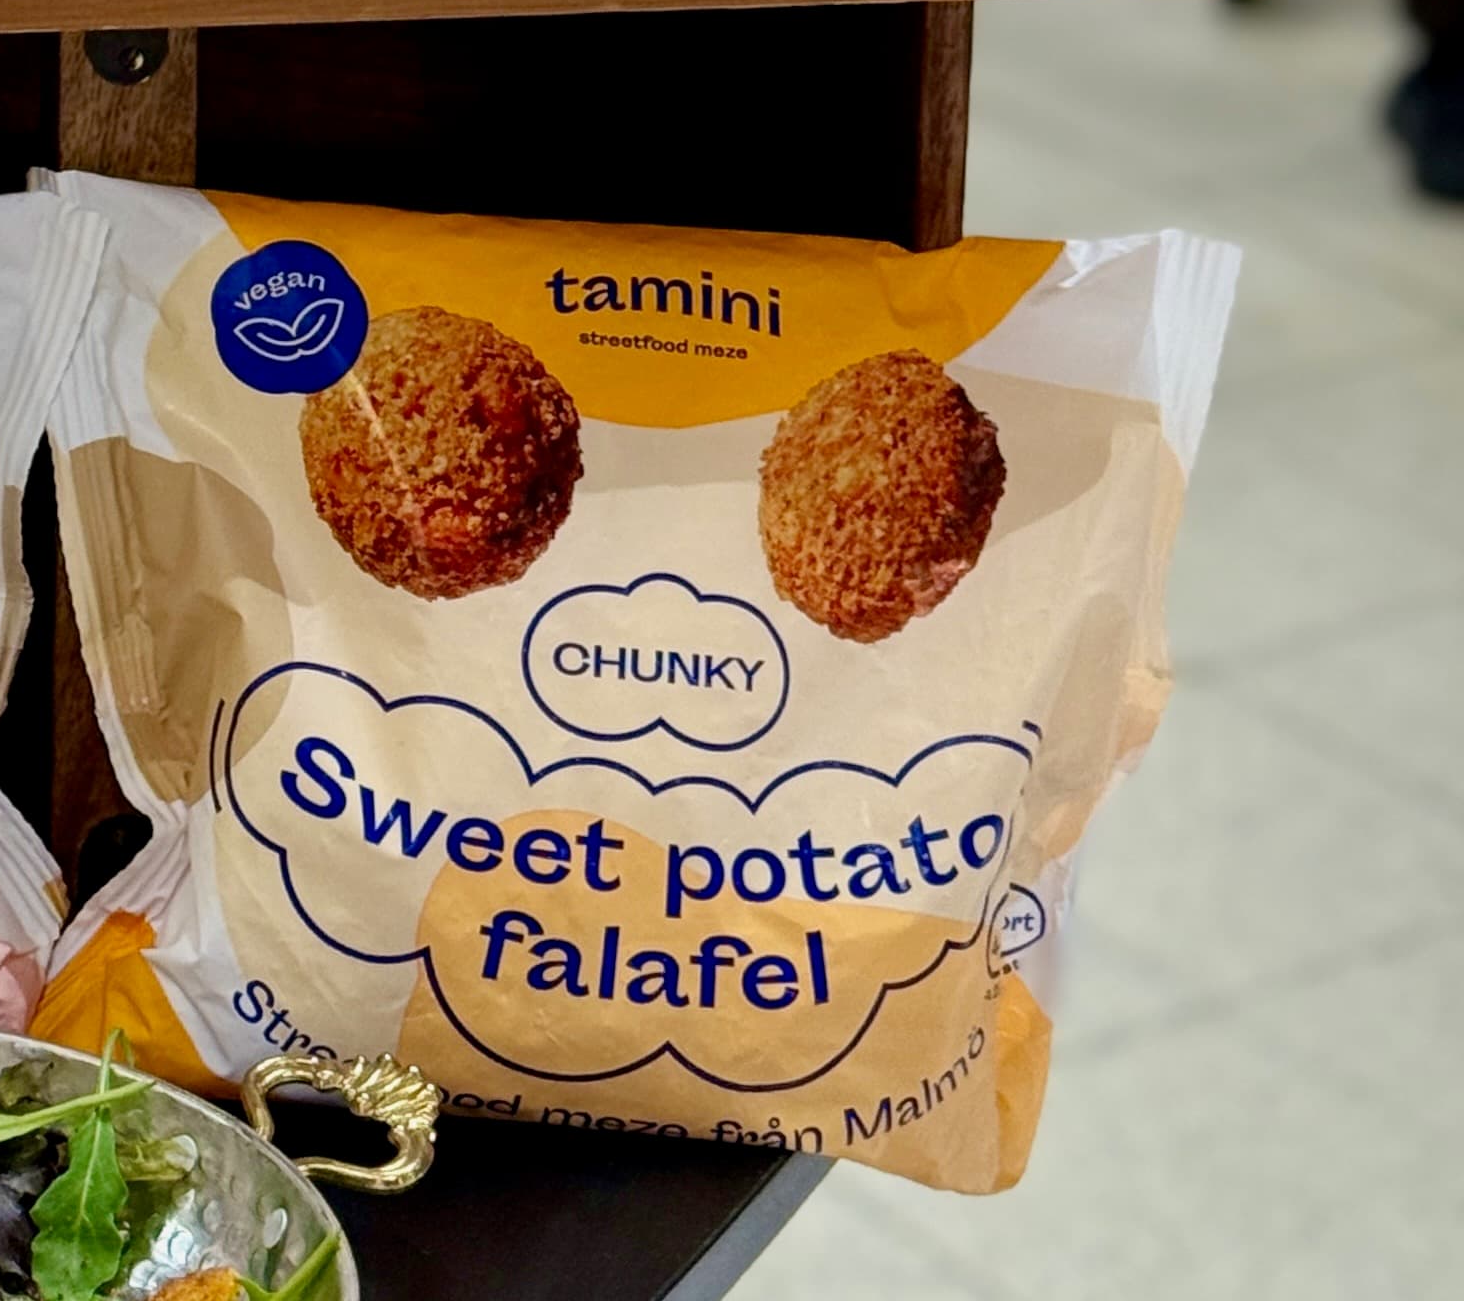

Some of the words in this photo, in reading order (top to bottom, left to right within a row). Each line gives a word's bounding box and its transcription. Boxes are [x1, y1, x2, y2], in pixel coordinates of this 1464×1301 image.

[234, 266, 327, 312] vegan
[545, 266, 784, 339] tamini
[578, 329, 689, 354] streetfood
[693, 343, 749, 360] meze
[552, 641, 766, 694] CHUNKY
[279, 737, 626, 894] Sweet
[664, 810, 1006, 920] potato
[477, 909, 832, 1011] falafel
[843, 1025, 986, 1146] Malmö
